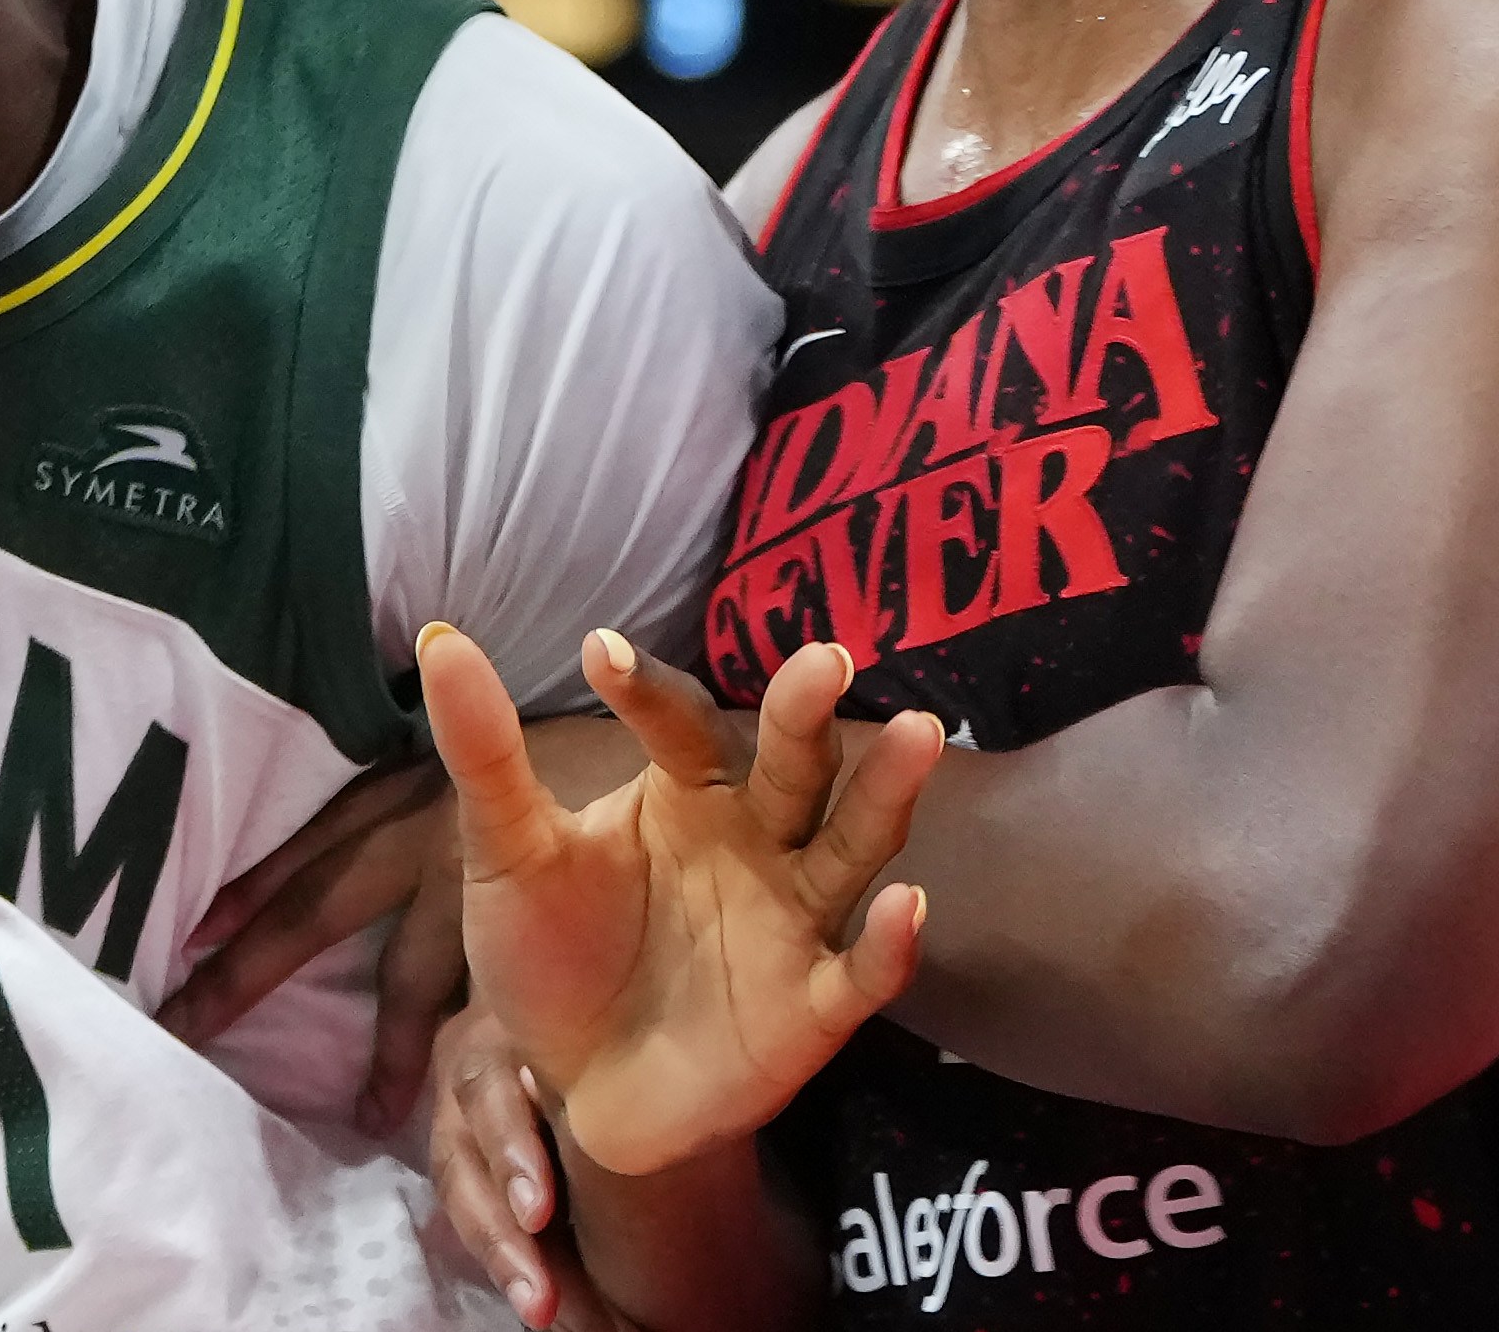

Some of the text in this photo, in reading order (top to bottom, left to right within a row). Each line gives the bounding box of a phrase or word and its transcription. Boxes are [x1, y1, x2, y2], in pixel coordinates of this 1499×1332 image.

[724, 225, 1220, 569] DIANA
[35, 461, 225, 531] SYMETRA
[830, 1158, 1228, 1313] alesforce
